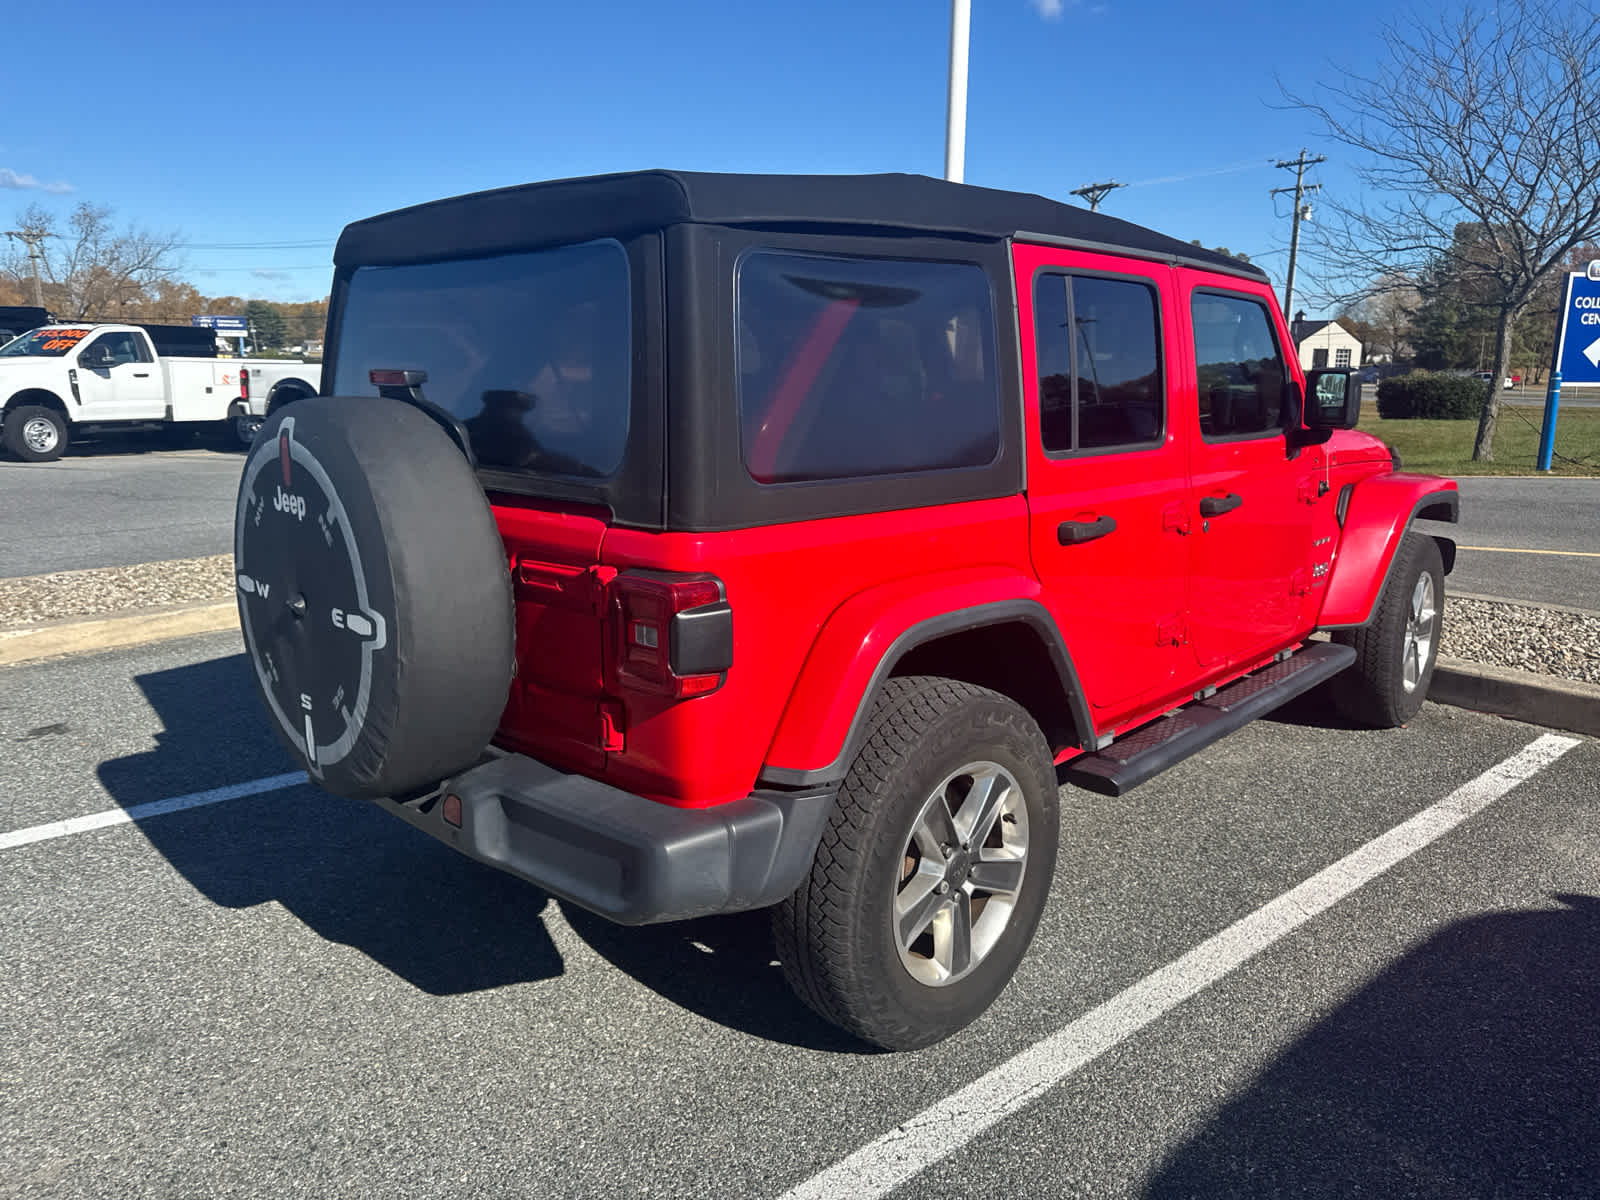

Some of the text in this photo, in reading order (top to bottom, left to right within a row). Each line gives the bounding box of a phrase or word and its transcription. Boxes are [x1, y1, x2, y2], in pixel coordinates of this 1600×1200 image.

[1575, 296, 1600, 309] COLL
[42, 339, 79, 350] OFF
[273, 485, 306, 521] Jeep
[256, 580, 270, 599] W
[332, 608, 345, 629] E
[300, 693, 313, 711] S
